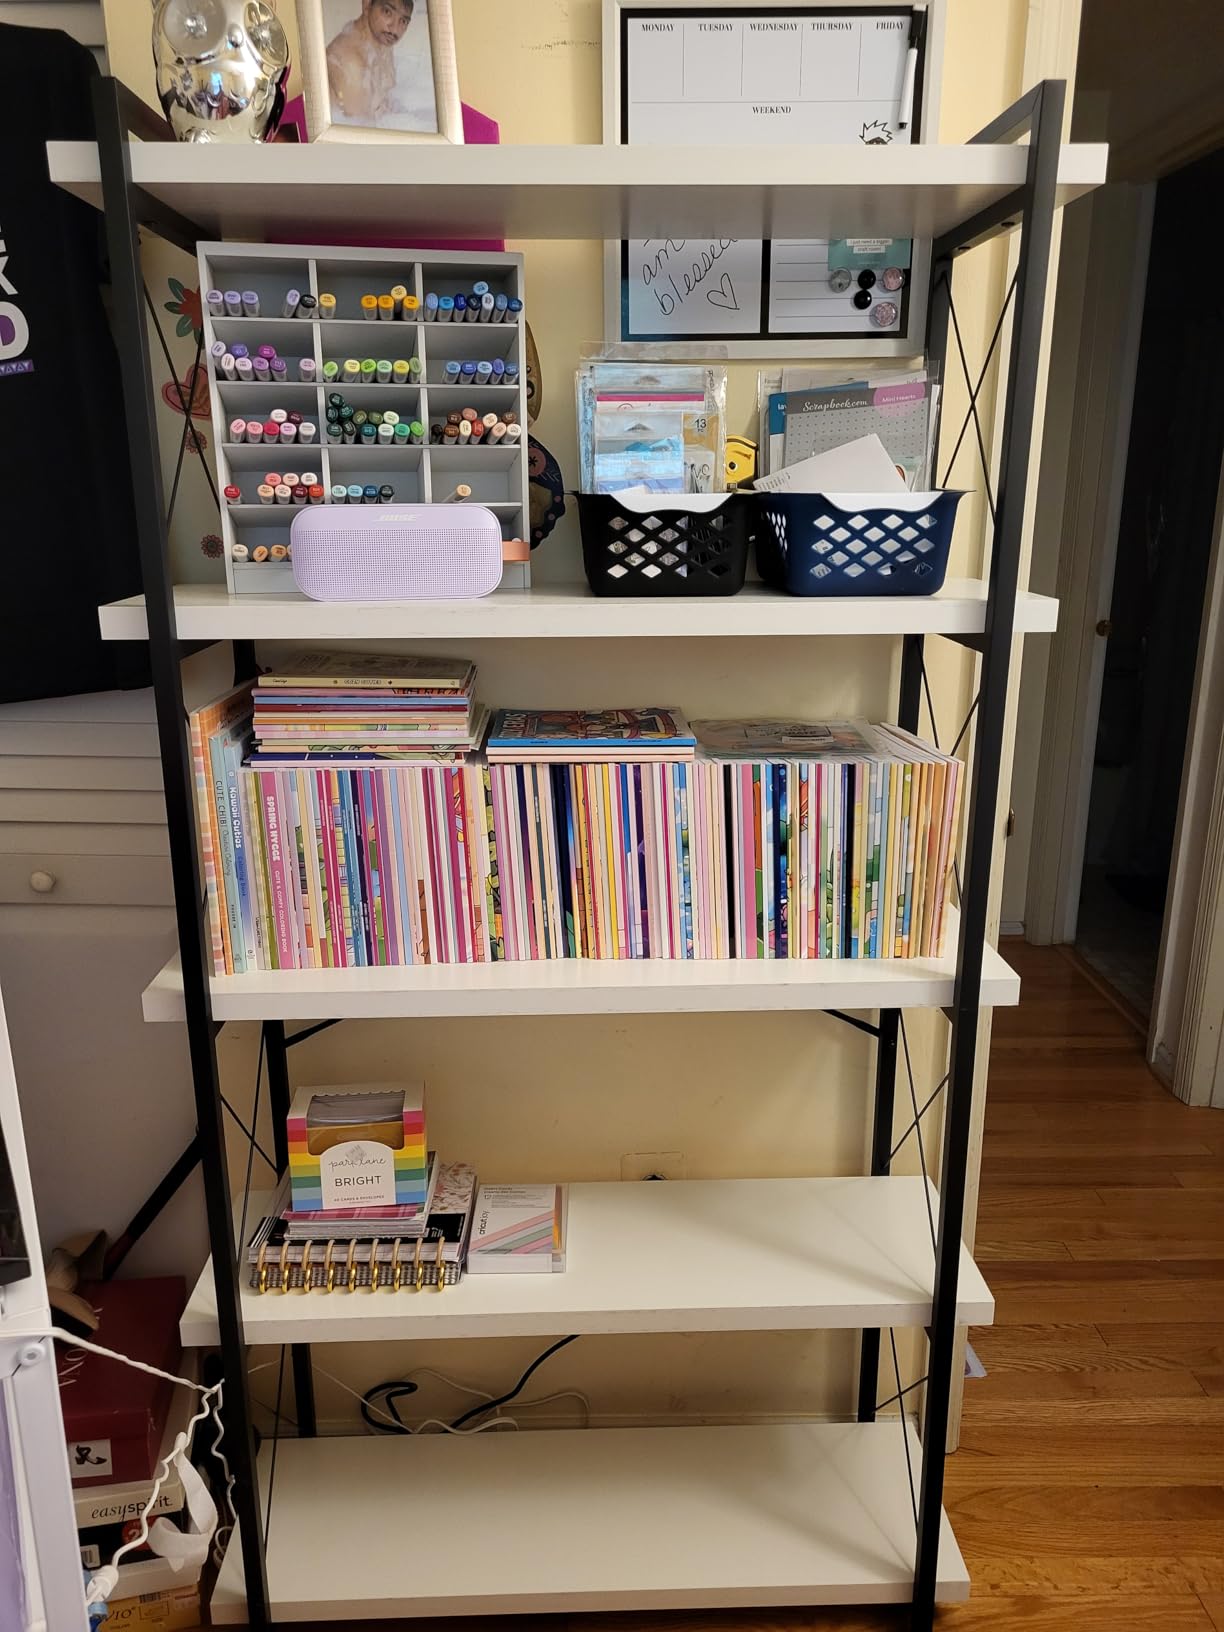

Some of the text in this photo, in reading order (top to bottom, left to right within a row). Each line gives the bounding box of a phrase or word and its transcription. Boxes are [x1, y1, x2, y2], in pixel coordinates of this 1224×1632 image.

[641, 23, 675, 32] MONDAY
[697, 22, 734, 32] TUESDAY
[749, 22, 799, 31] WEDNESDAY
[810, 21, 853, 31] THURSDAY
[875, 21, 905, 31] FRIDAY
[751, 105, 792, 115] WEEKEND
[802, 398, 868, 412] Scrapbook.com
[694, 418, 707, 429] 13
[215, 780, 225, 802] CUTE
[229, 786, 239, 818] Kawaii
[218, 805, 227, 826] CHIBI
[266, 795, 278, 830] SPRING
[269, 830, 281, 861] HYGGE
[278, 909, 287, 938] COLORING
[334, 1175, 382, 1187] BRIGHT
